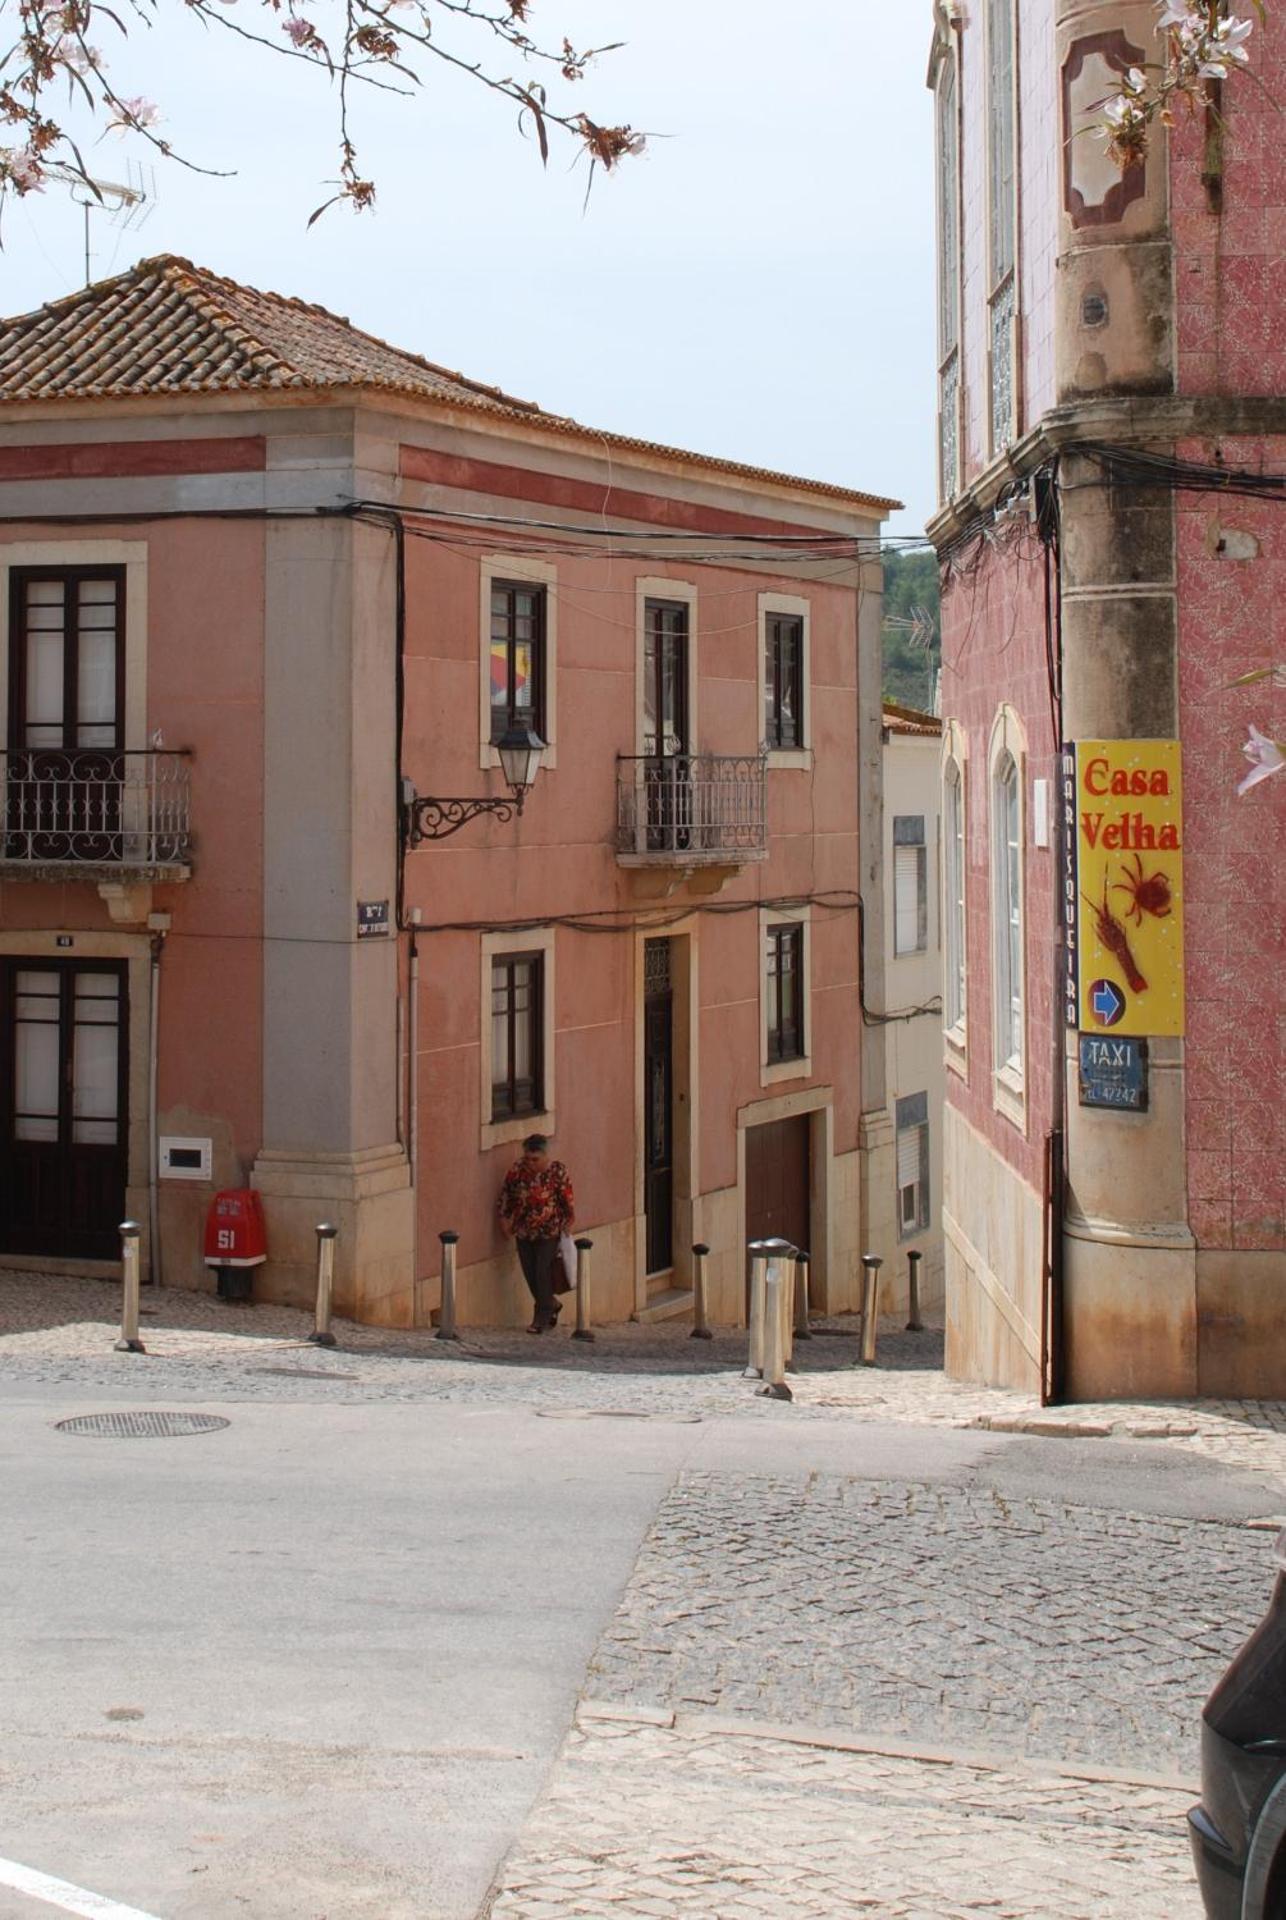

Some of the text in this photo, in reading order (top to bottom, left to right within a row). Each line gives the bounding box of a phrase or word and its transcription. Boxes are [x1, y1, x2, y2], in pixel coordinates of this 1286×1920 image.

[1084, 758, 1169, 796] Casa
[1081, 812, 1181, 850] Velha
[1063, 755, 1075, 1024] MARISQUEIRA
[1090, 1042, 1131, 1067] TAXI
